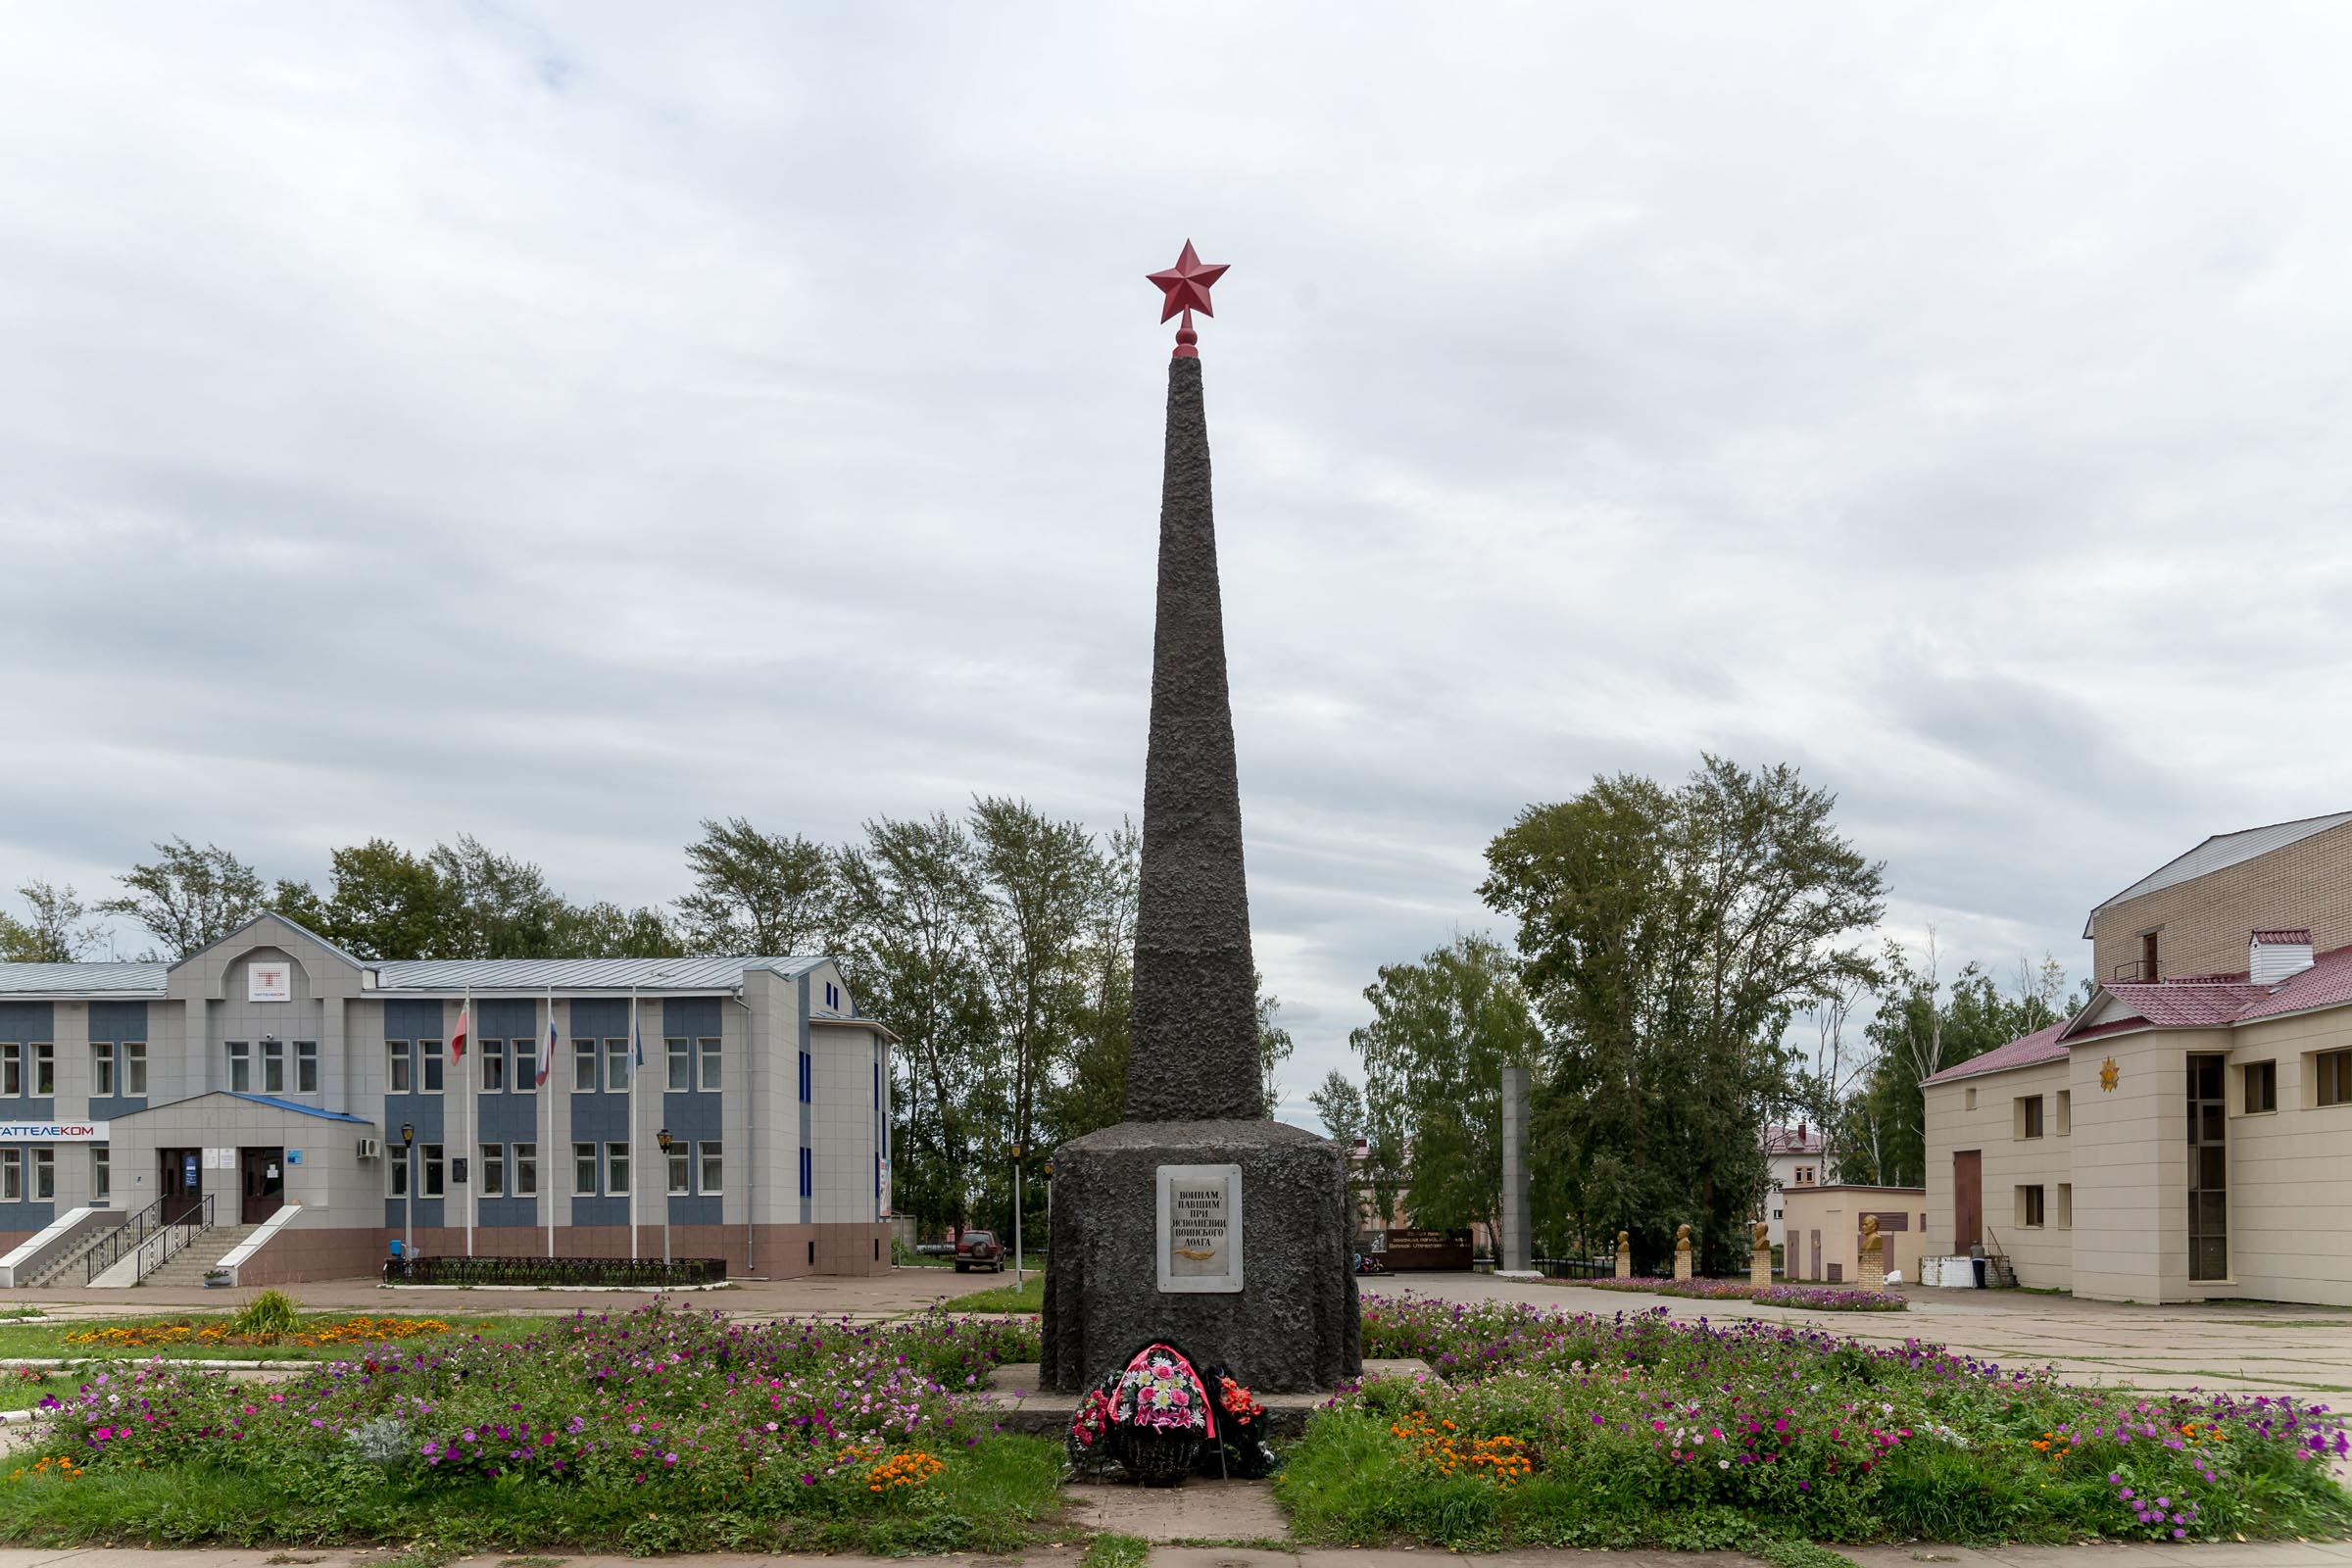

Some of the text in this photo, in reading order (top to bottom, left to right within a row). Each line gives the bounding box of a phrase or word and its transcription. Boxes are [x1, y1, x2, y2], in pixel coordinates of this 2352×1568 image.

[0, 1126, 94, 1136] АТТЕЛЕКОМ
[1190, 1209, 1208, 1218] ПРИ
[1184, 1238, 1211, 1247] ДОЛГА
